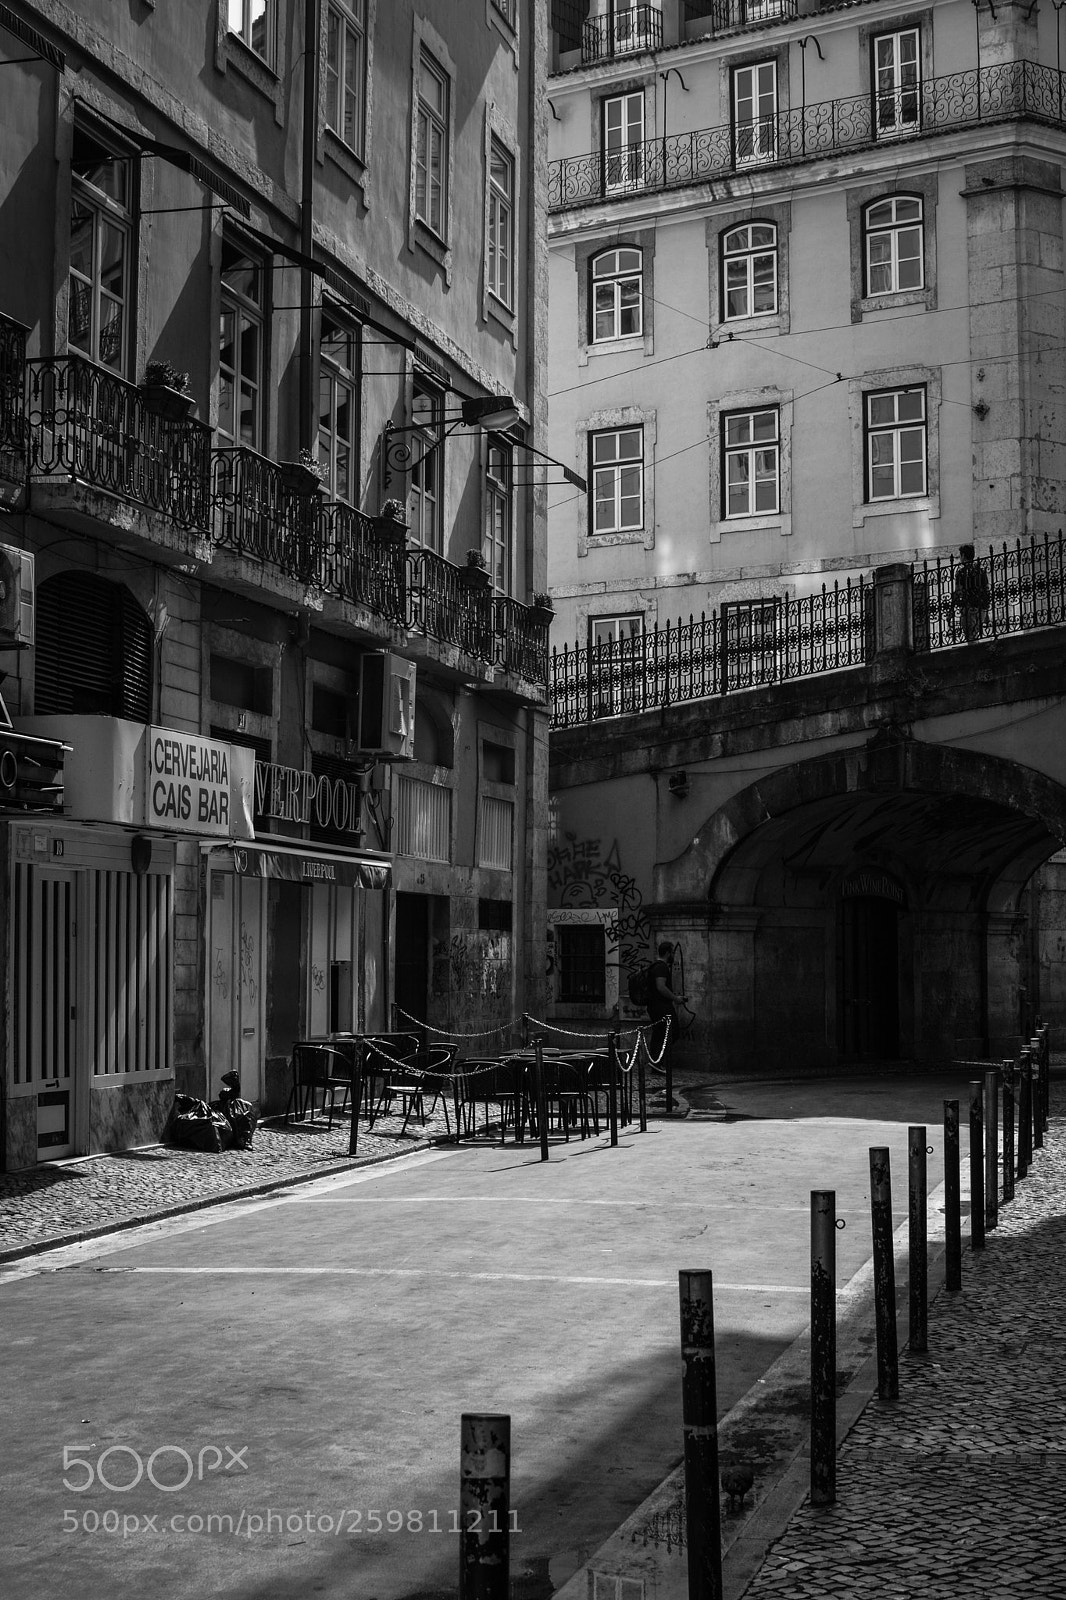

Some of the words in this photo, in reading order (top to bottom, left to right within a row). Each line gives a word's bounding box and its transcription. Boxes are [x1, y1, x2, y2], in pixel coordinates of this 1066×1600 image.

[154, 737, 229, 786] CERVEJARIA
[152, 780, 192, 821] CAIS
[197, 787, 229, 826] BAR
[302, 861, 337, 881] LIVERPOOL
[859, 873, 881, 894] WINE
[881, 876, 905, 905] POINT
